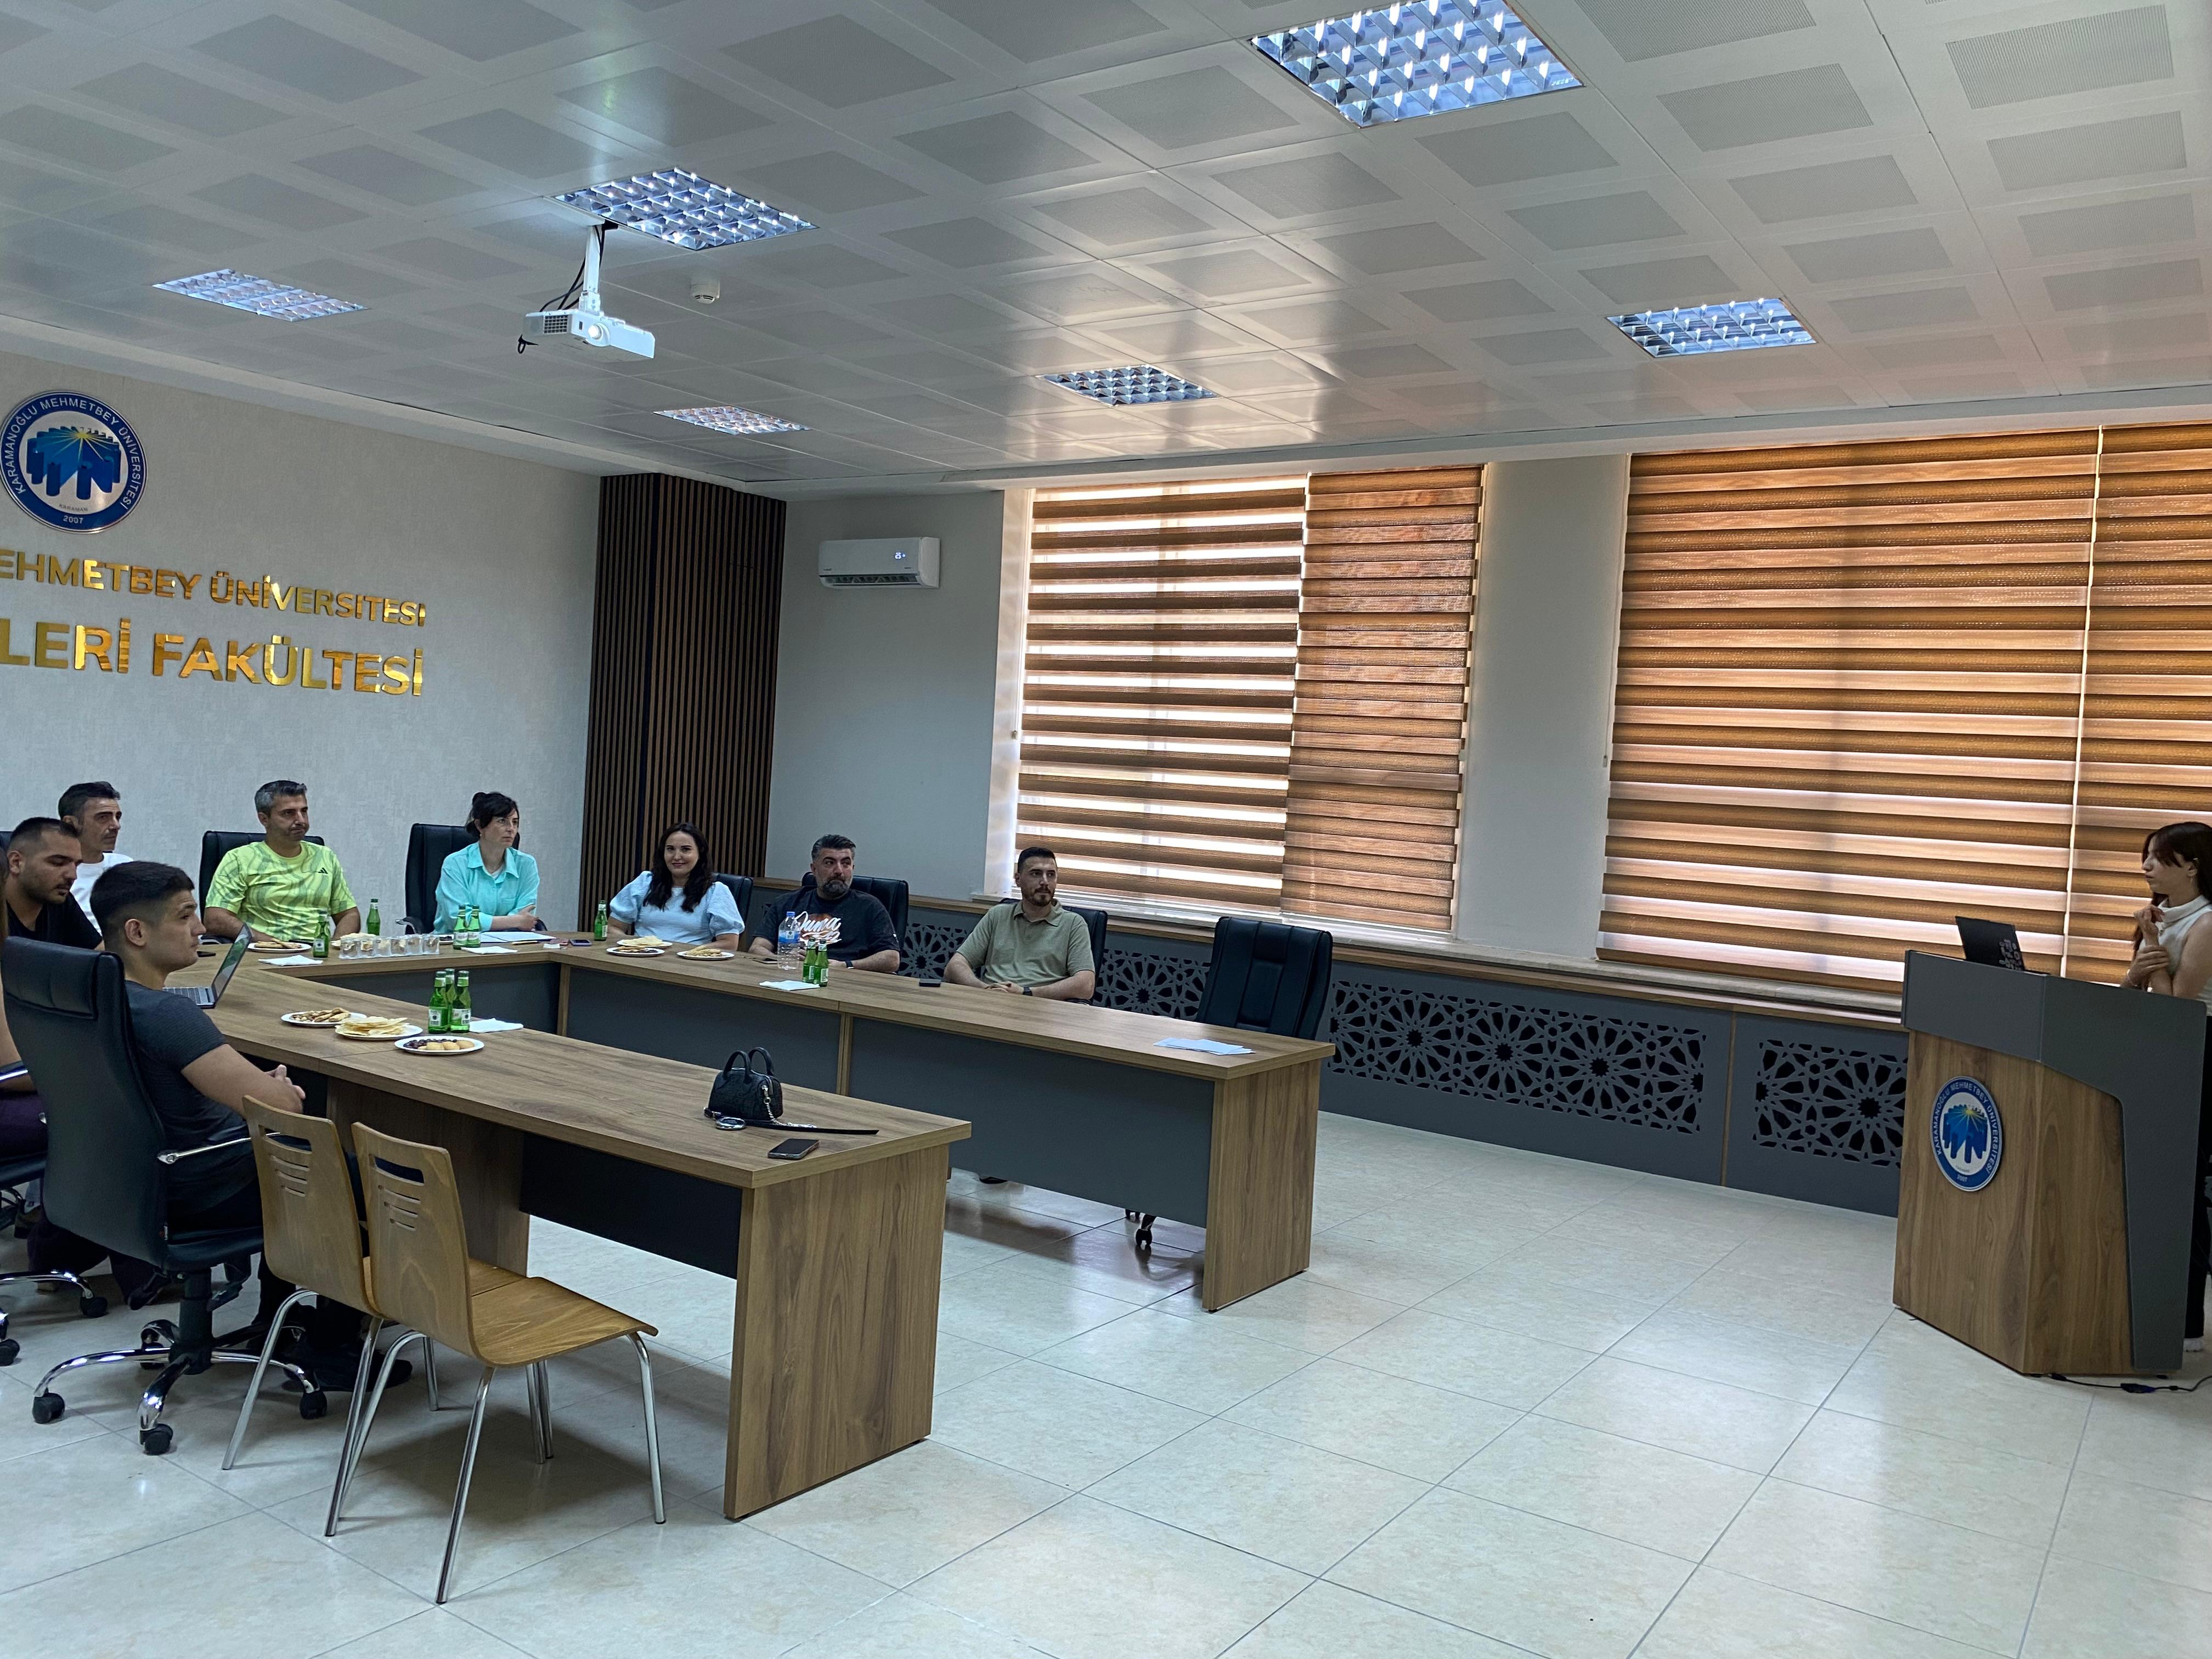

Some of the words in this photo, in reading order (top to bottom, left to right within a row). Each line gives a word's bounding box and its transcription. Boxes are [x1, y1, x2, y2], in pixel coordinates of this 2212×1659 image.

[40, 397, 119, 426] MEHMETBEY
[63, 515, 84, 524] 2007
[0, 618, 131, 674] LERİ
[153, 633, 424, 696] FAKÜLTESİ
